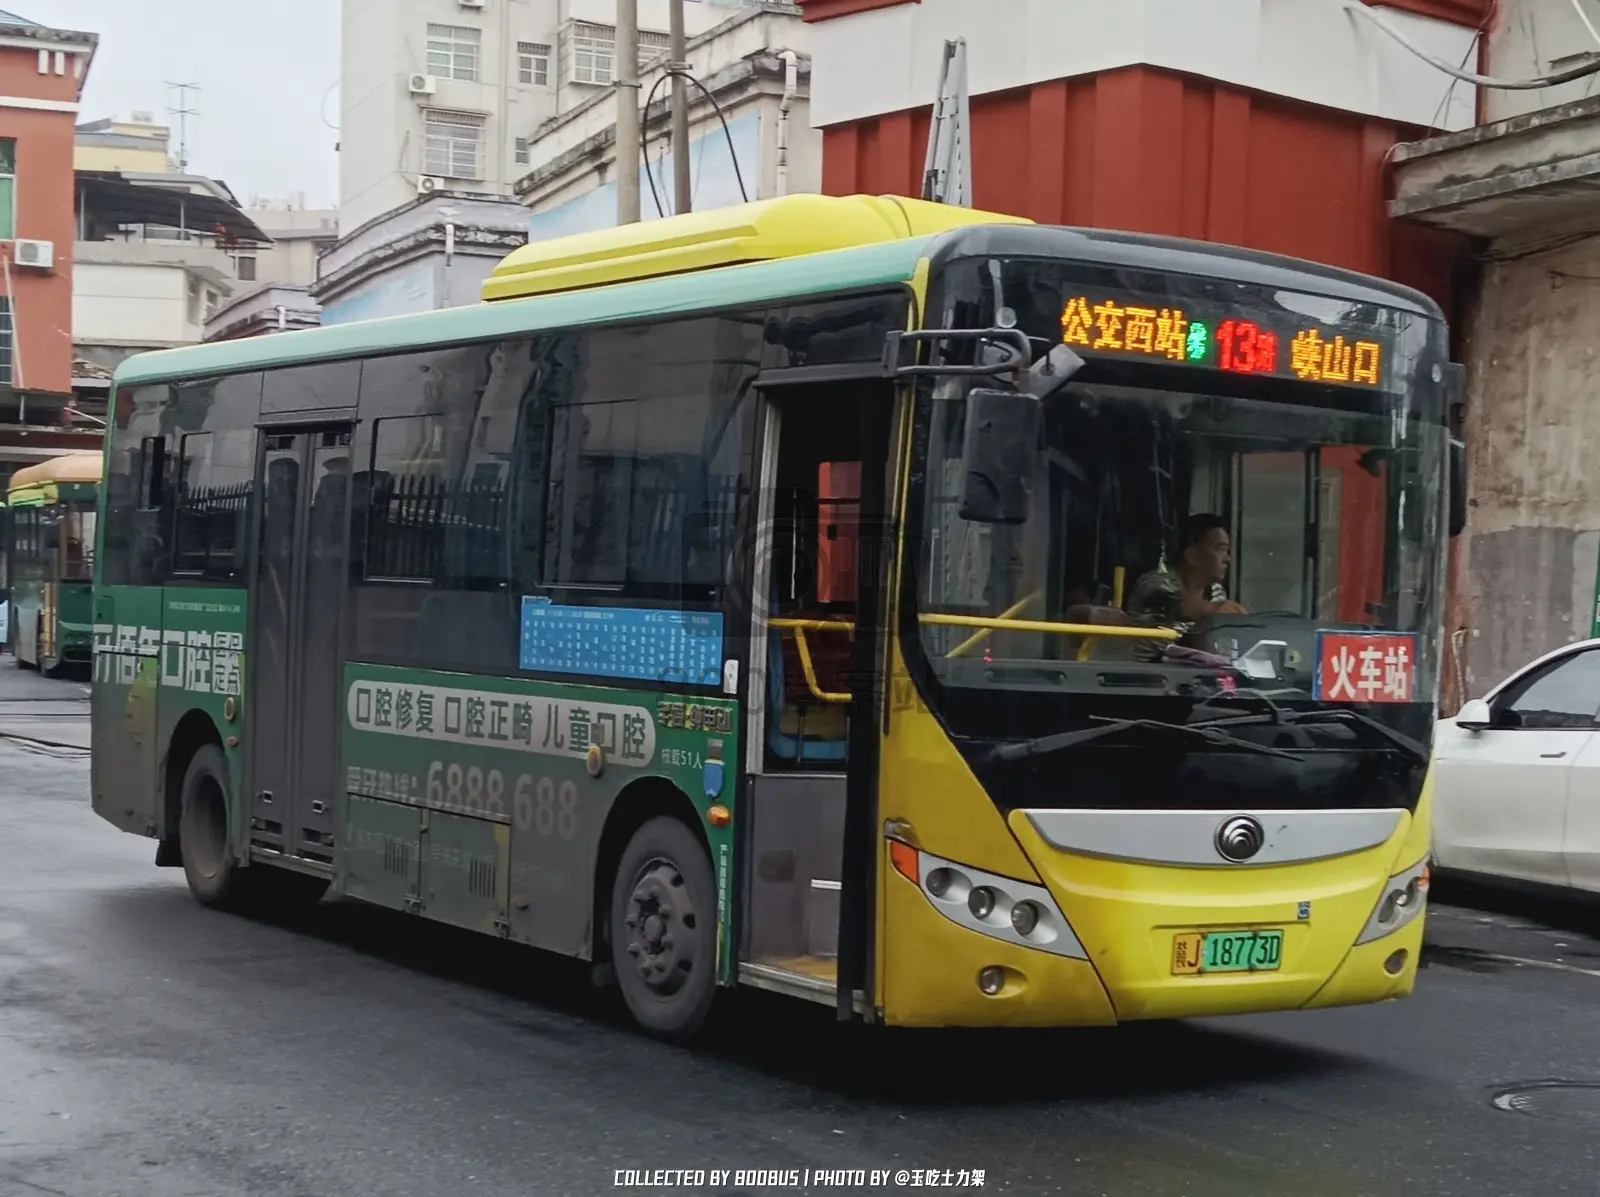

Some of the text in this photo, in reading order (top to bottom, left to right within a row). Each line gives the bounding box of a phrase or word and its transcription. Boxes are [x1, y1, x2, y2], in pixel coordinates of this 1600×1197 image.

[1061, 296, 1187, 360] 公交西站
[1327, 645, 1409, 699] 火车站
[355, 687, 436, 734] 口腔修复
[444, 696, 533, 746] 口腔正畸
[542, 703, 646, 760] 儿童口腔
